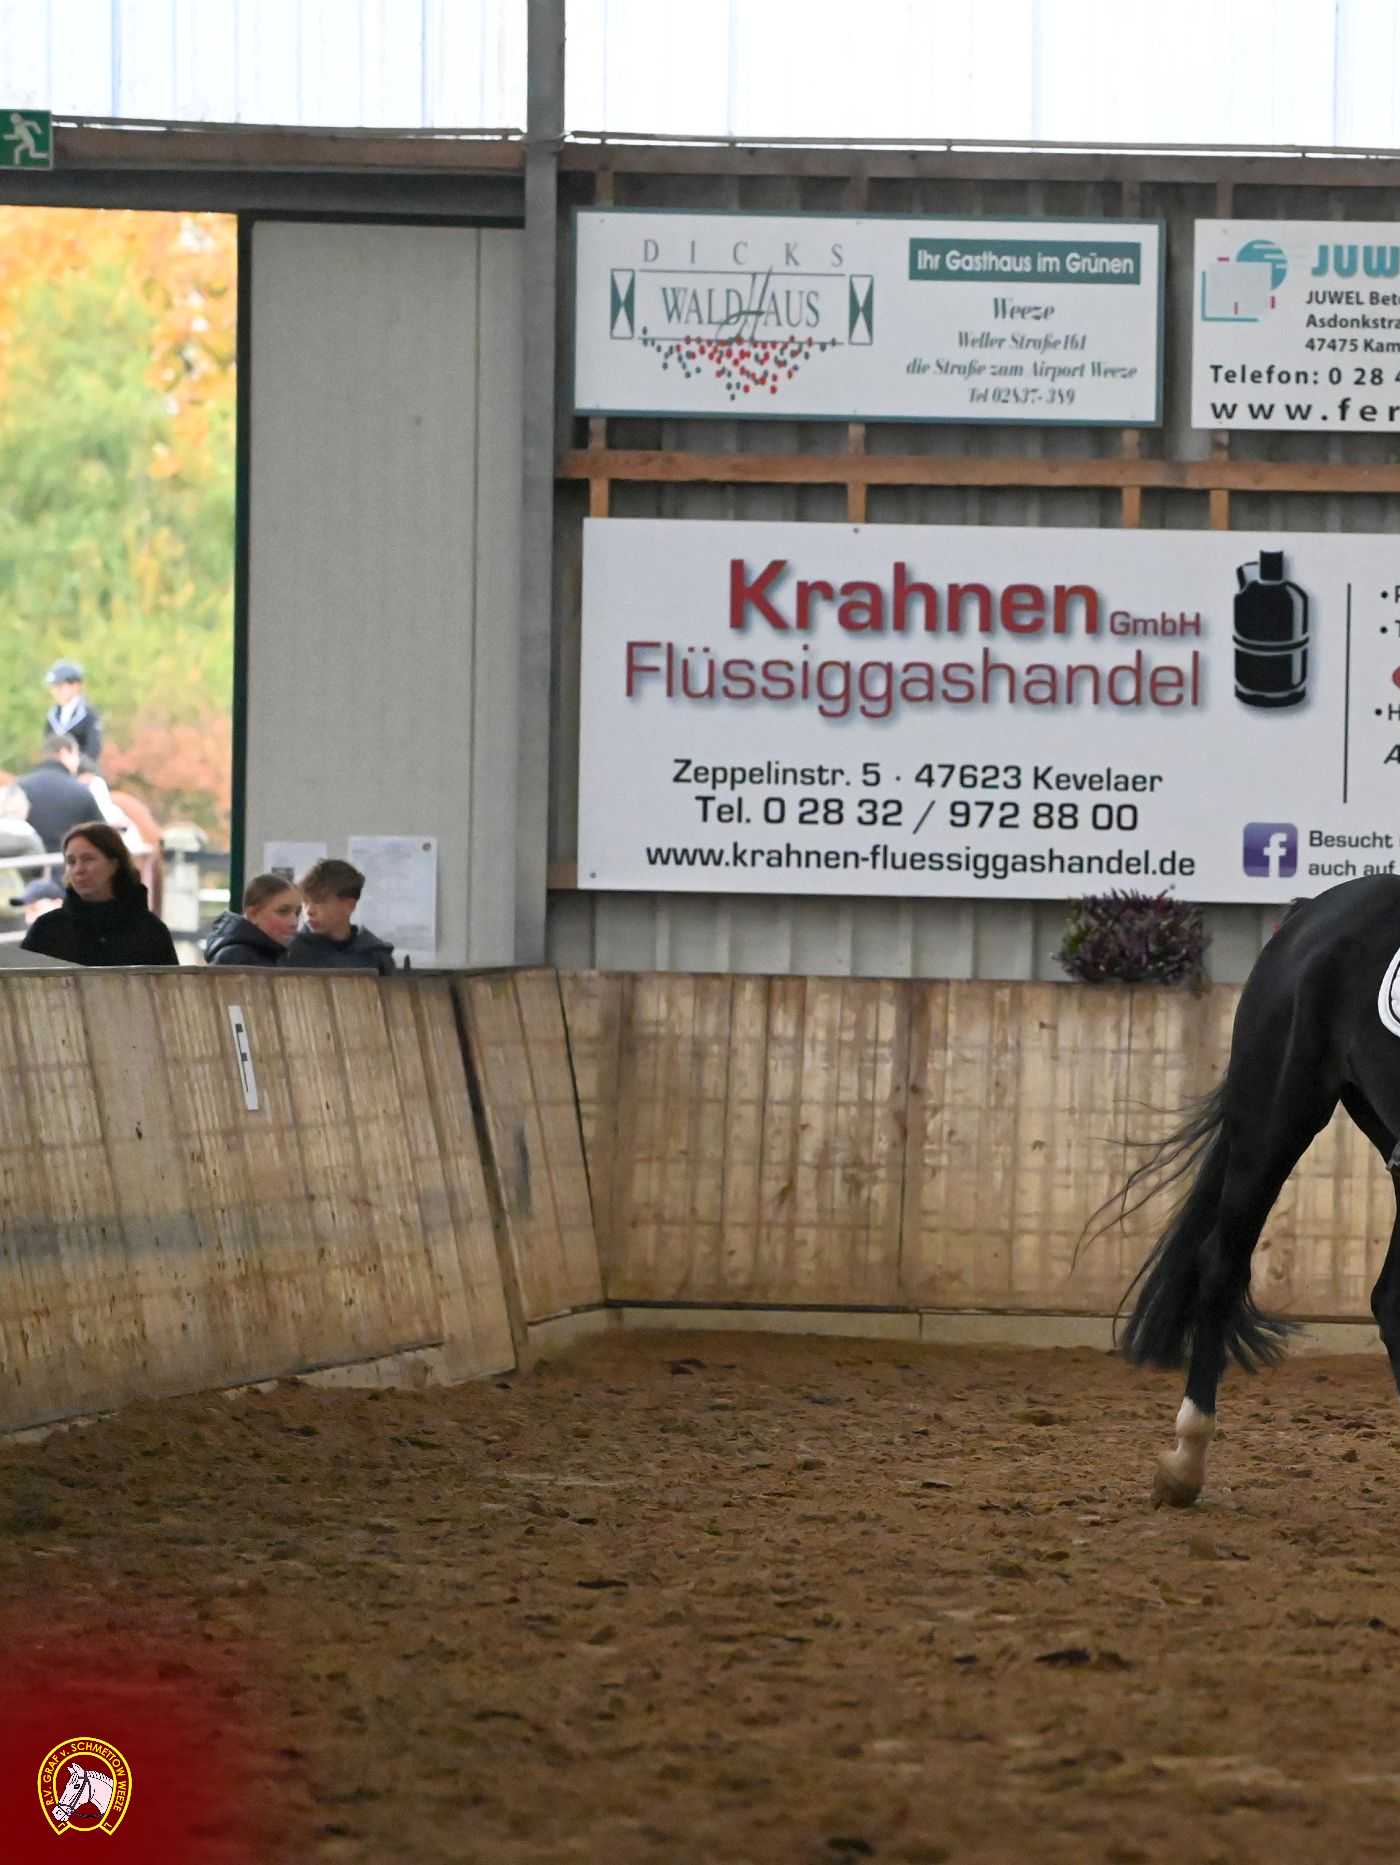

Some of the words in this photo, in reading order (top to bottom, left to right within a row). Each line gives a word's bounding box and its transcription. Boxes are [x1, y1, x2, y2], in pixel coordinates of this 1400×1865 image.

[643, 239, 844, 268] DICKS
[917, 250, 941, 271] Ihr
[946, 249, 1031, 273] Gasthaus
[1037, 252, 1060, 273] im
[1066, 252, 1134, 275] Grünen
[661, 267, 820, 340] WALDHAUS
[993, 297, 1055, 320] Weeze
[1305, 291, 1364, 306] JUWEL
[1009, 332, 1061, 353] Straße
[1305, 338, 1358, 352] 47475
[906, 358, 930, 375] die
[934, 358, 986, 380] Straße
[990, 364, 1024, 377] zum
[1031, 361, 1085, 382] Airport
[1091, 362, 1138, 378] Weeze
[1210, 365, 1319, 385] Telefon:
[1328, 367, 1342, 386] 0
[1353, 367, 1384, 386] 28
[729, 558, 1098, 635] Krahnen
[1109, 610, 1200, 636] GmbH
[625, 641, 1200, 718] Flüssiggashandel
[673, 758, 852, 791] Zeppelinstr.
[862, 762, 881, 787] 5
[915, 764, 1021, 790] 47623
[1033, 765, 1163, 792] Kevelaer
[695, 795, 751, 823] Tel.
[763, 796, 786, 824] 0
[798, 797, 844, 825] 28
[857, 798, 902, 826] 32
[949, 801, 1020, 828] 972
[1032, 802, 1079, 830] 88
[1092, 803, 1138, 831] 00
[1308, 830, 1394, 849] Besucht
[646, 841, 1196, 879] www.krahnen-fluessiggashandel.de
[1308, 860, 1356, 876] auch
[1363, 860, 1395, 877] auf
